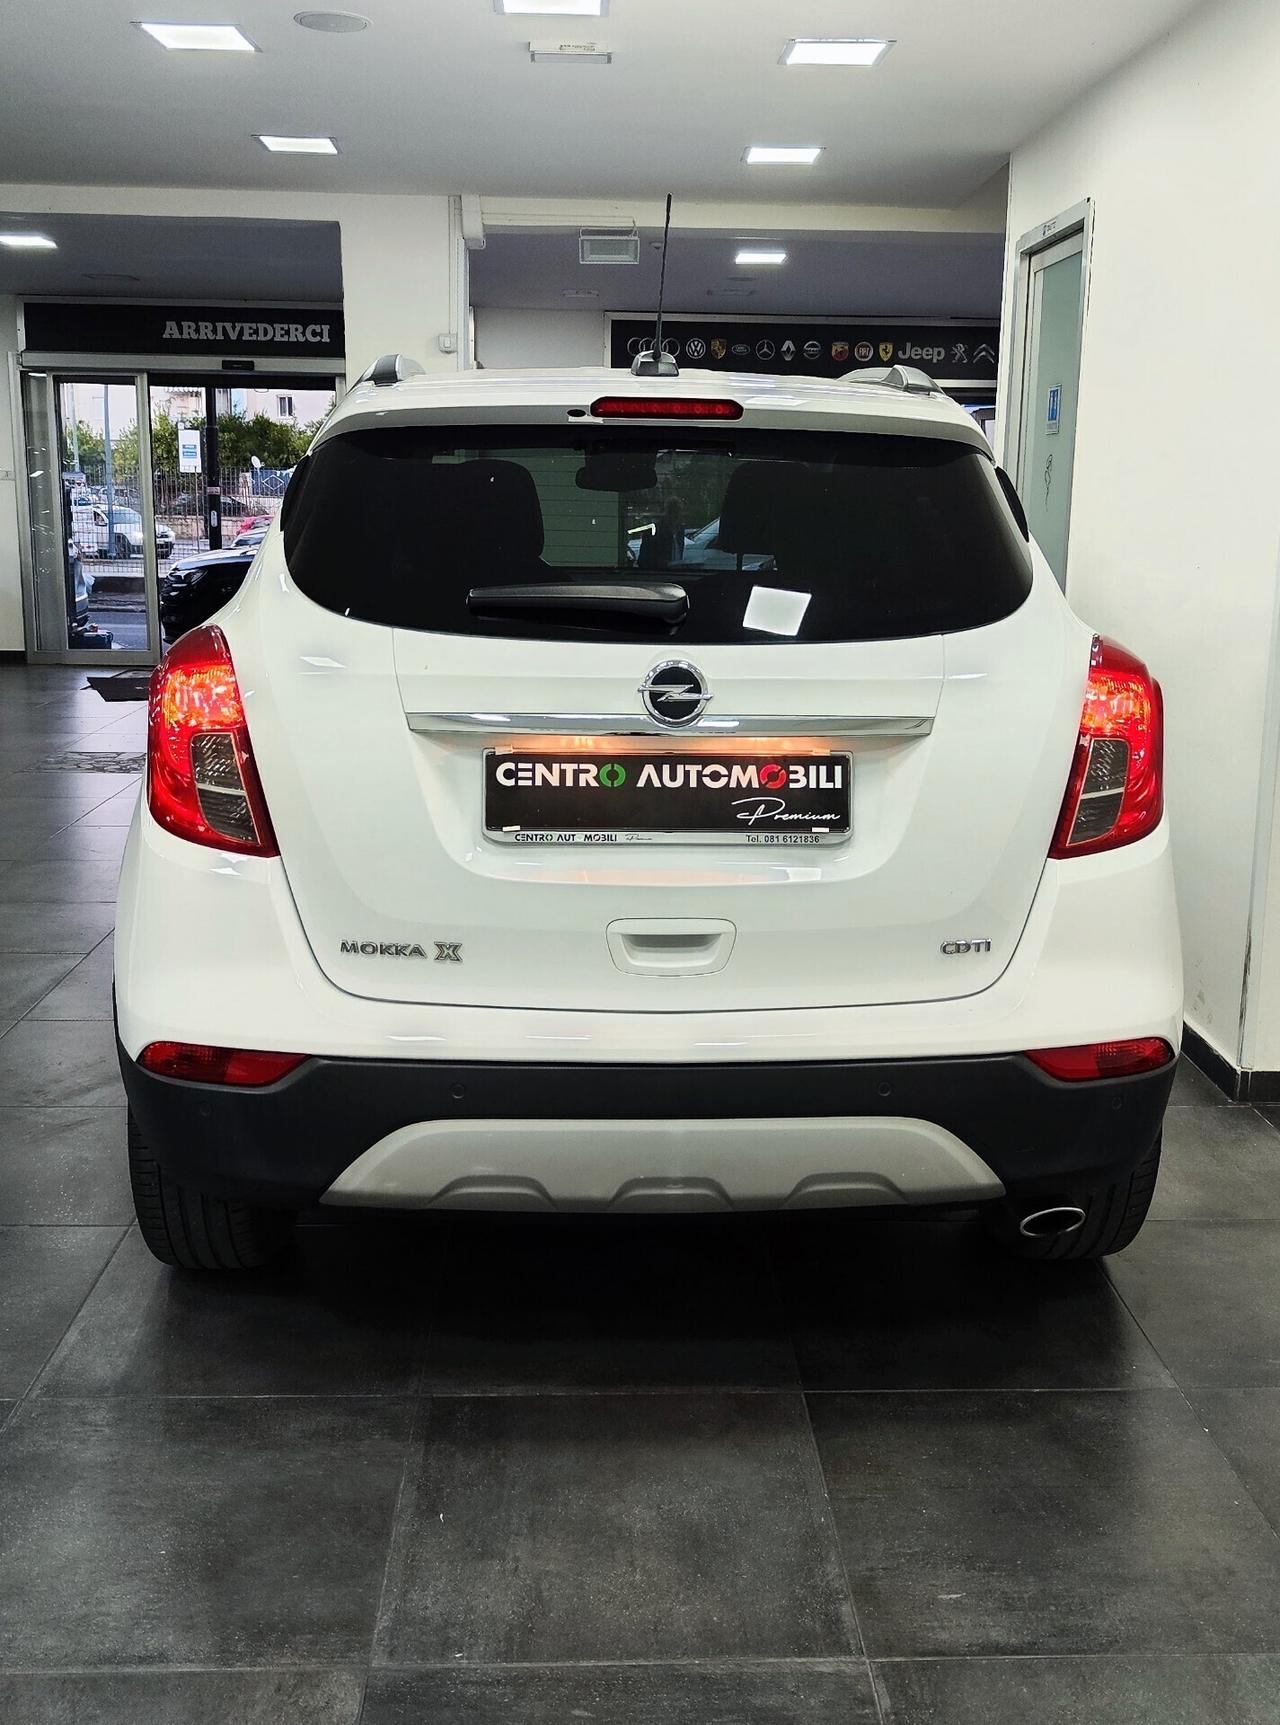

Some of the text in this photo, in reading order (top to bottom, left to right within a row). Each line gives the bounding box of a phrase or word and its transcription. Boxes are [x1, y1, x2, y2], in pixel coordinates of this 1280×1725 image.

[162, 321, 331, 342] ARRIVEDERCI
[898, 342, 945, 363] Jeep
[496, 762, 842, 789] CENTRO AUTOMOBILI
[731, 797, 841, 825] Premium
[514, 833, 553, 842] CENTRO
[746, 834, 820, 844] Tel. 081 6121836
[340, 940, 463, 962] MOKKA X
[940, 938, 992, 954] CDTI
